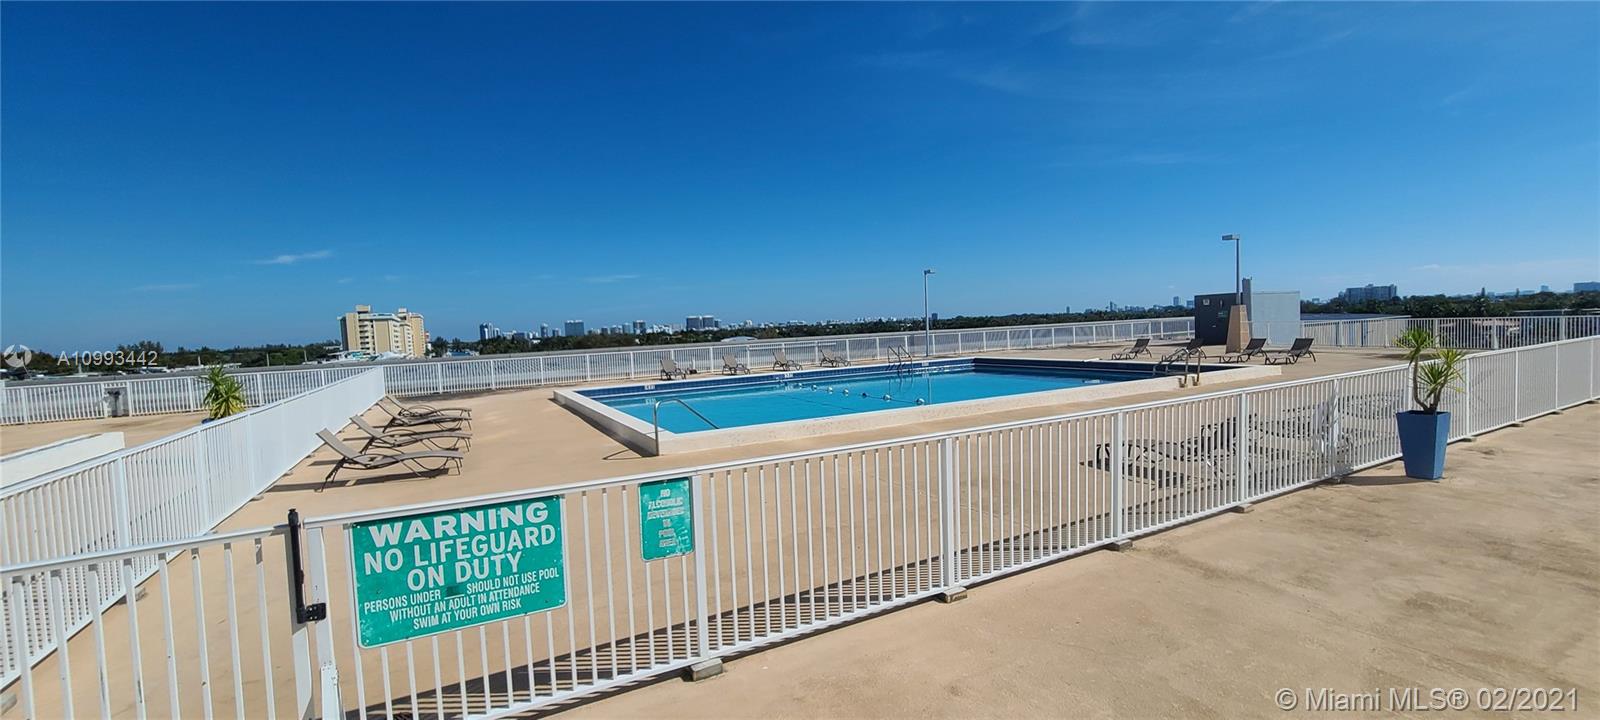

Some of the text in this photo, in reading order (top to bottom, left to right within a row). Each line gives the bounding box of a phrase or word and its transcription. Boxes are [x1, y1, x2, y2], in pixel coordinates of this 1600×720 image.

[368, 501, 548, 548] WARNING
[363, 524, 556, 576] NO LIFEGUARD
[407, 551, 522, 591] ON DUTY
[364, 567, 559, 615] PERSONS UNDER SHOULD NOT USE POOL
[389, 582, 540, 623] WITHOUT AN ADULT IN ATTENDANCE
[413, 598, 522, 630] SWIM AT YOUR OWN RISK
